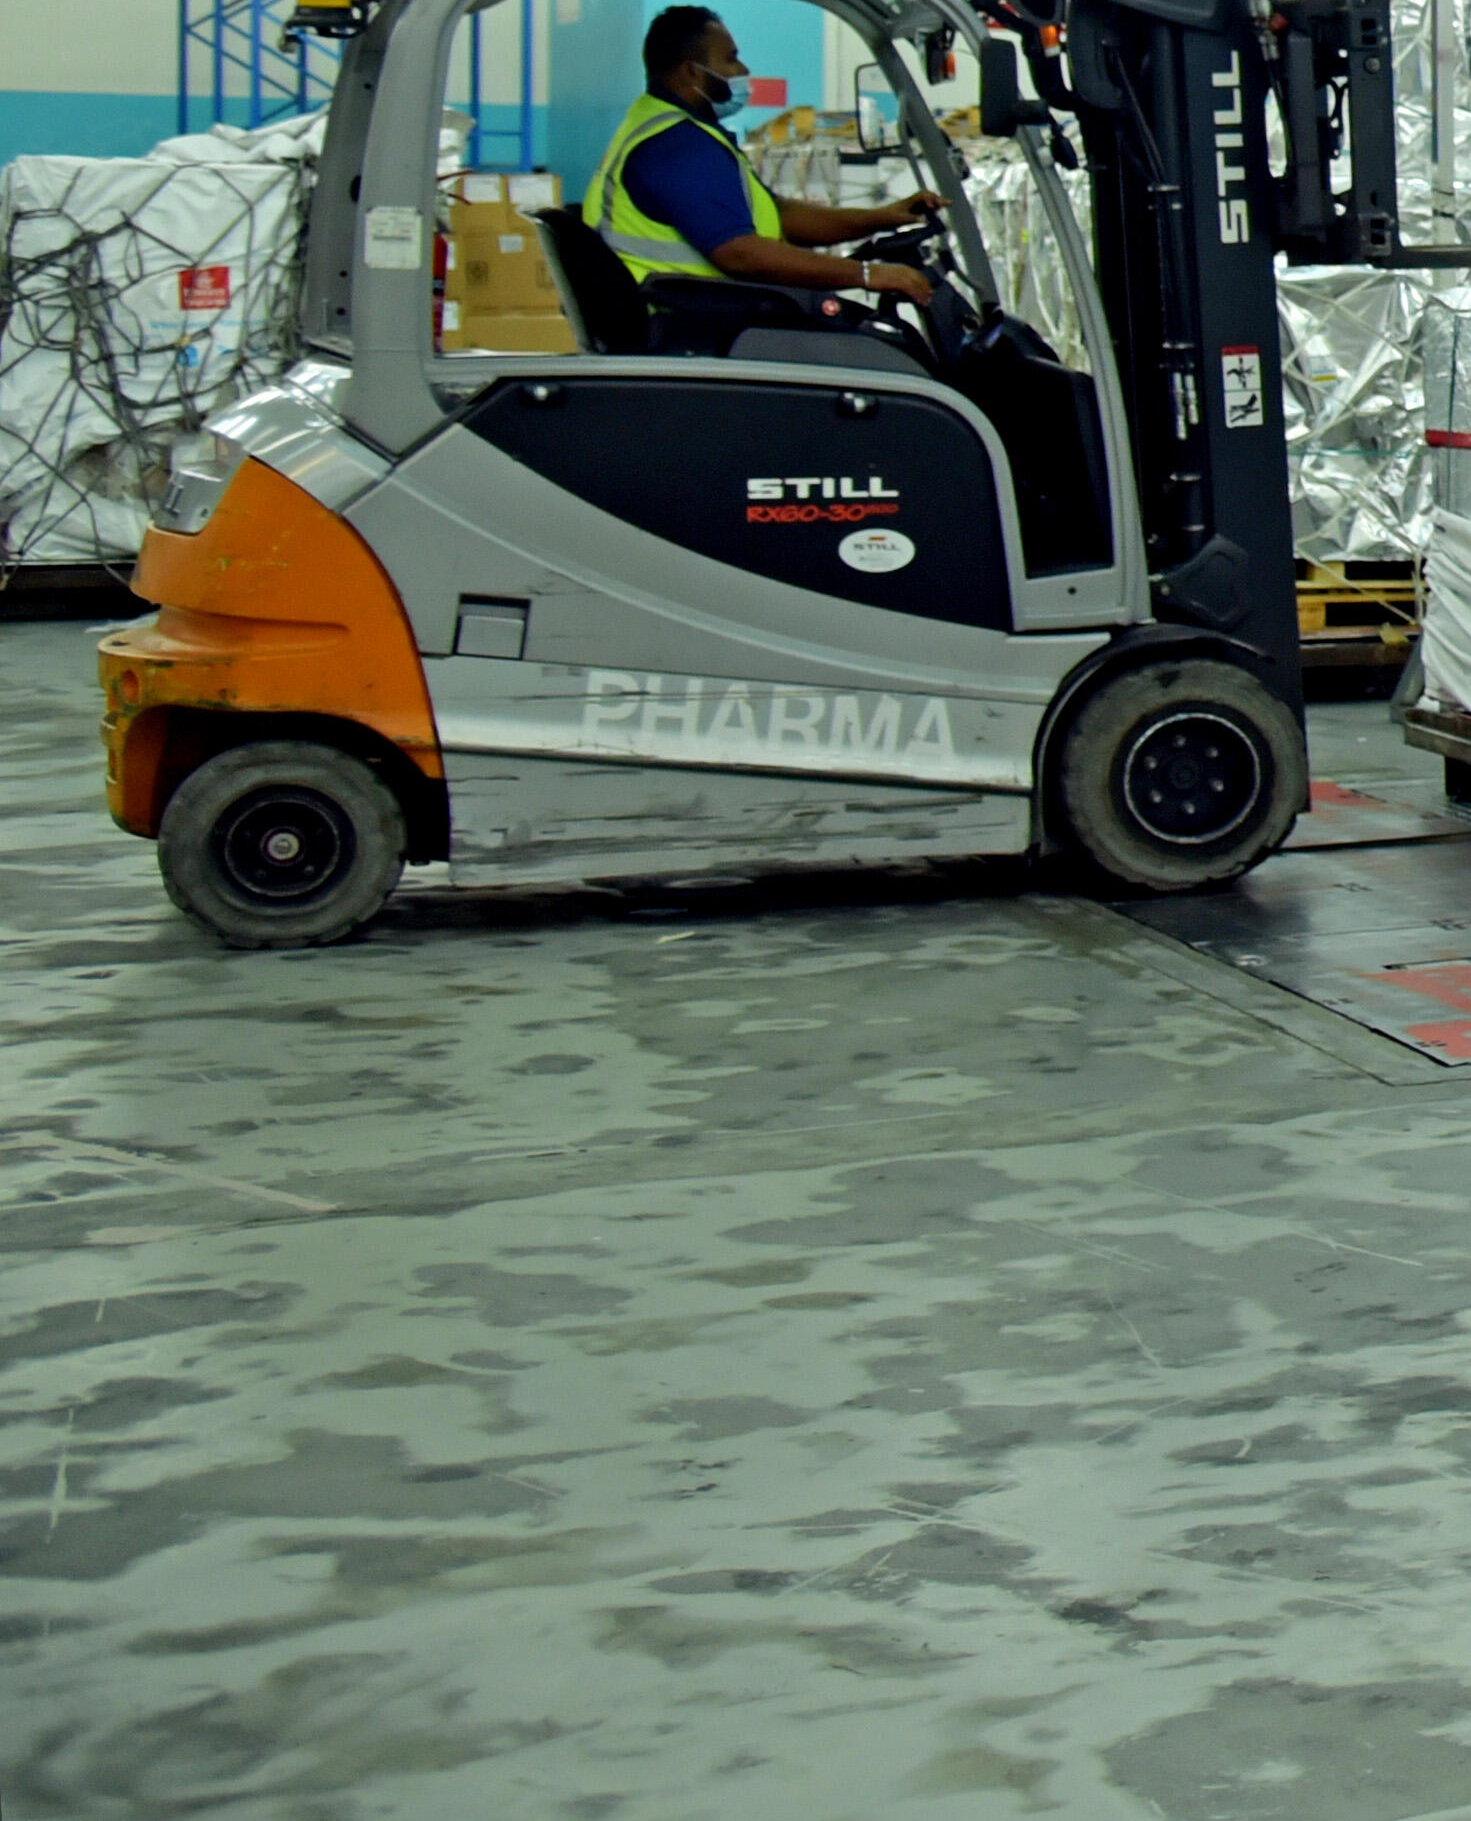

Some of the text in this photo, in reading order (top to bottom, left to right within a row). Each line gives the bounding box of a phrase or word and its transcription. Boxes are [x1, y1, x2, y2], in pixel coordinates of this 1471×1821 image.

[1211, 49, 1250, 244] STILL
[747, 477, 899, 499] STILL
[580, 667, 958, 759] PHARMA
